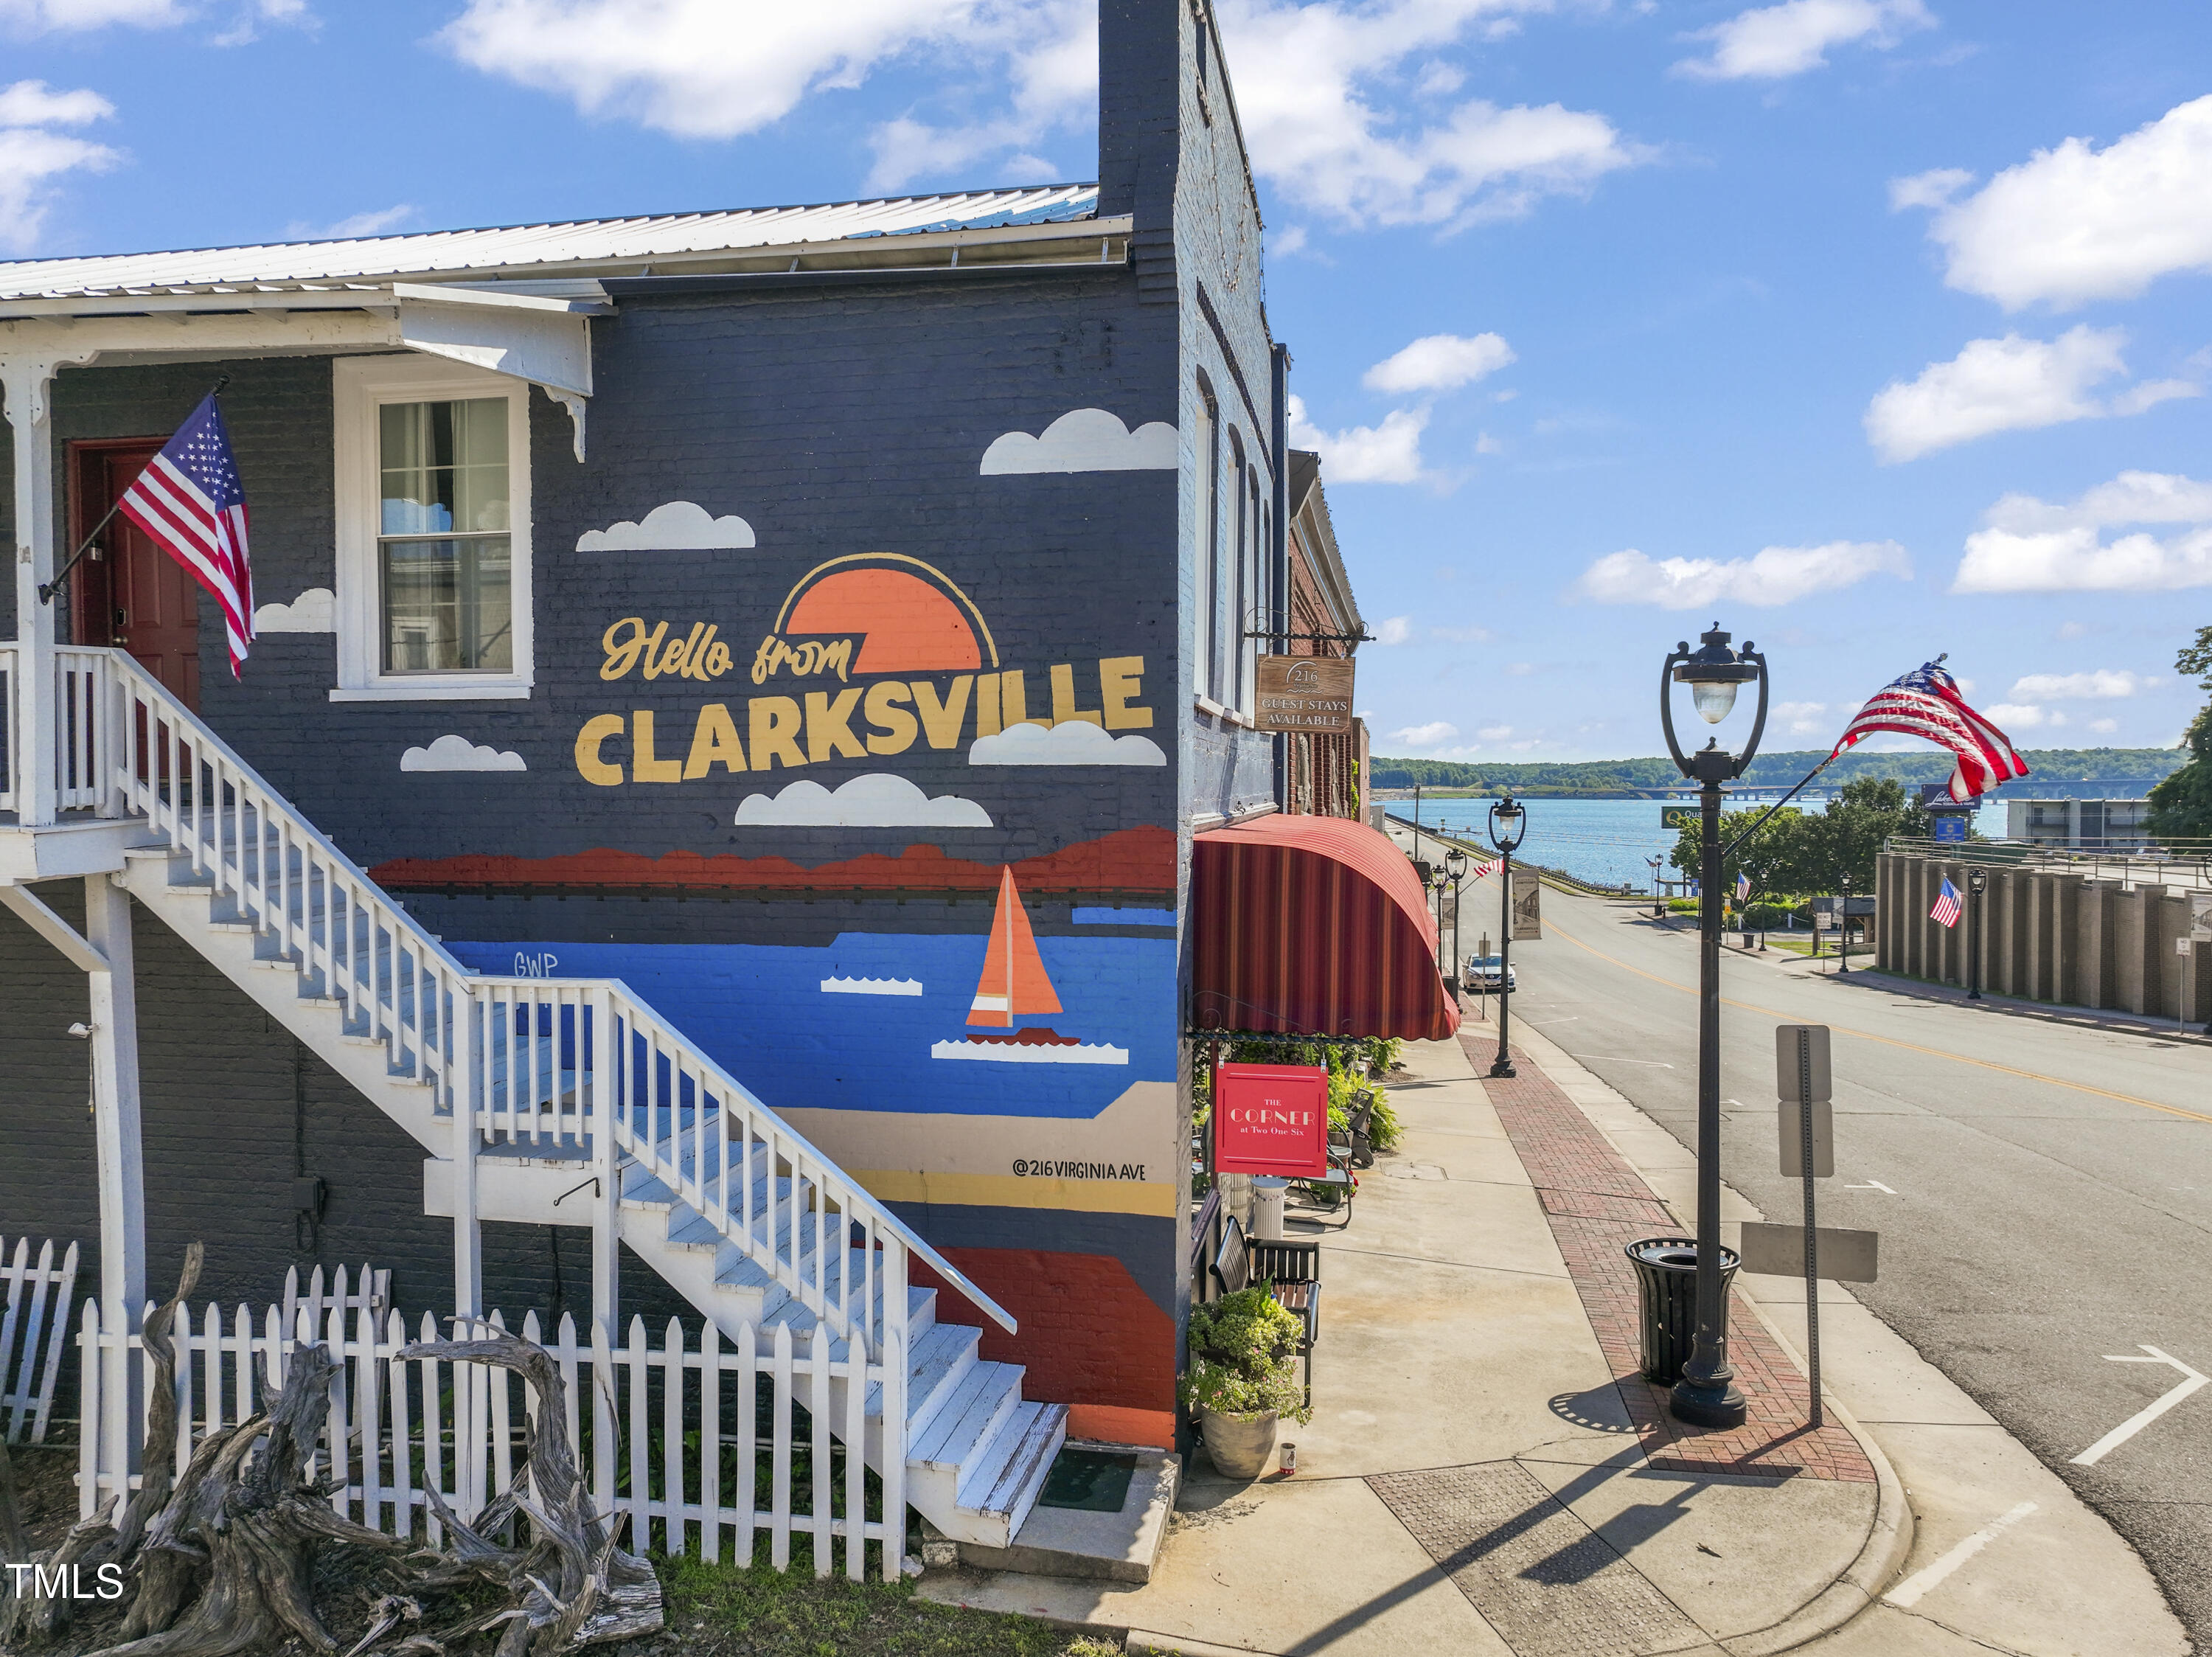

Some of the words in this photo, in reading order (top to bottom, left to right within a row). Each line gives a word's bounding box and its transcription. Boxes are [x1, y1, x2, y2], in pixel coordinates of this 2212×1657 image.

[601, 617, 734, 681] Hello
[751, 634, 853, 684] from
[1294, 670, 1318, 682] 216
[1262, 699, 1306, 709] GUEST
[1308, 701, 1348, 712] STAYS
[574, 656, 1153, 786] CLARKSVILLE
[1267, 714, 1340, 726] AVAILABLE
[1230, 1108, 1316, 1126] CORNER
[1251, 1126, 1268, 1134] Two
[1270, 1127, 1288, 1136] One
[1290, 1128, 1304, 1136] Six
[1119, 1164, 1146, 1181] AVE
